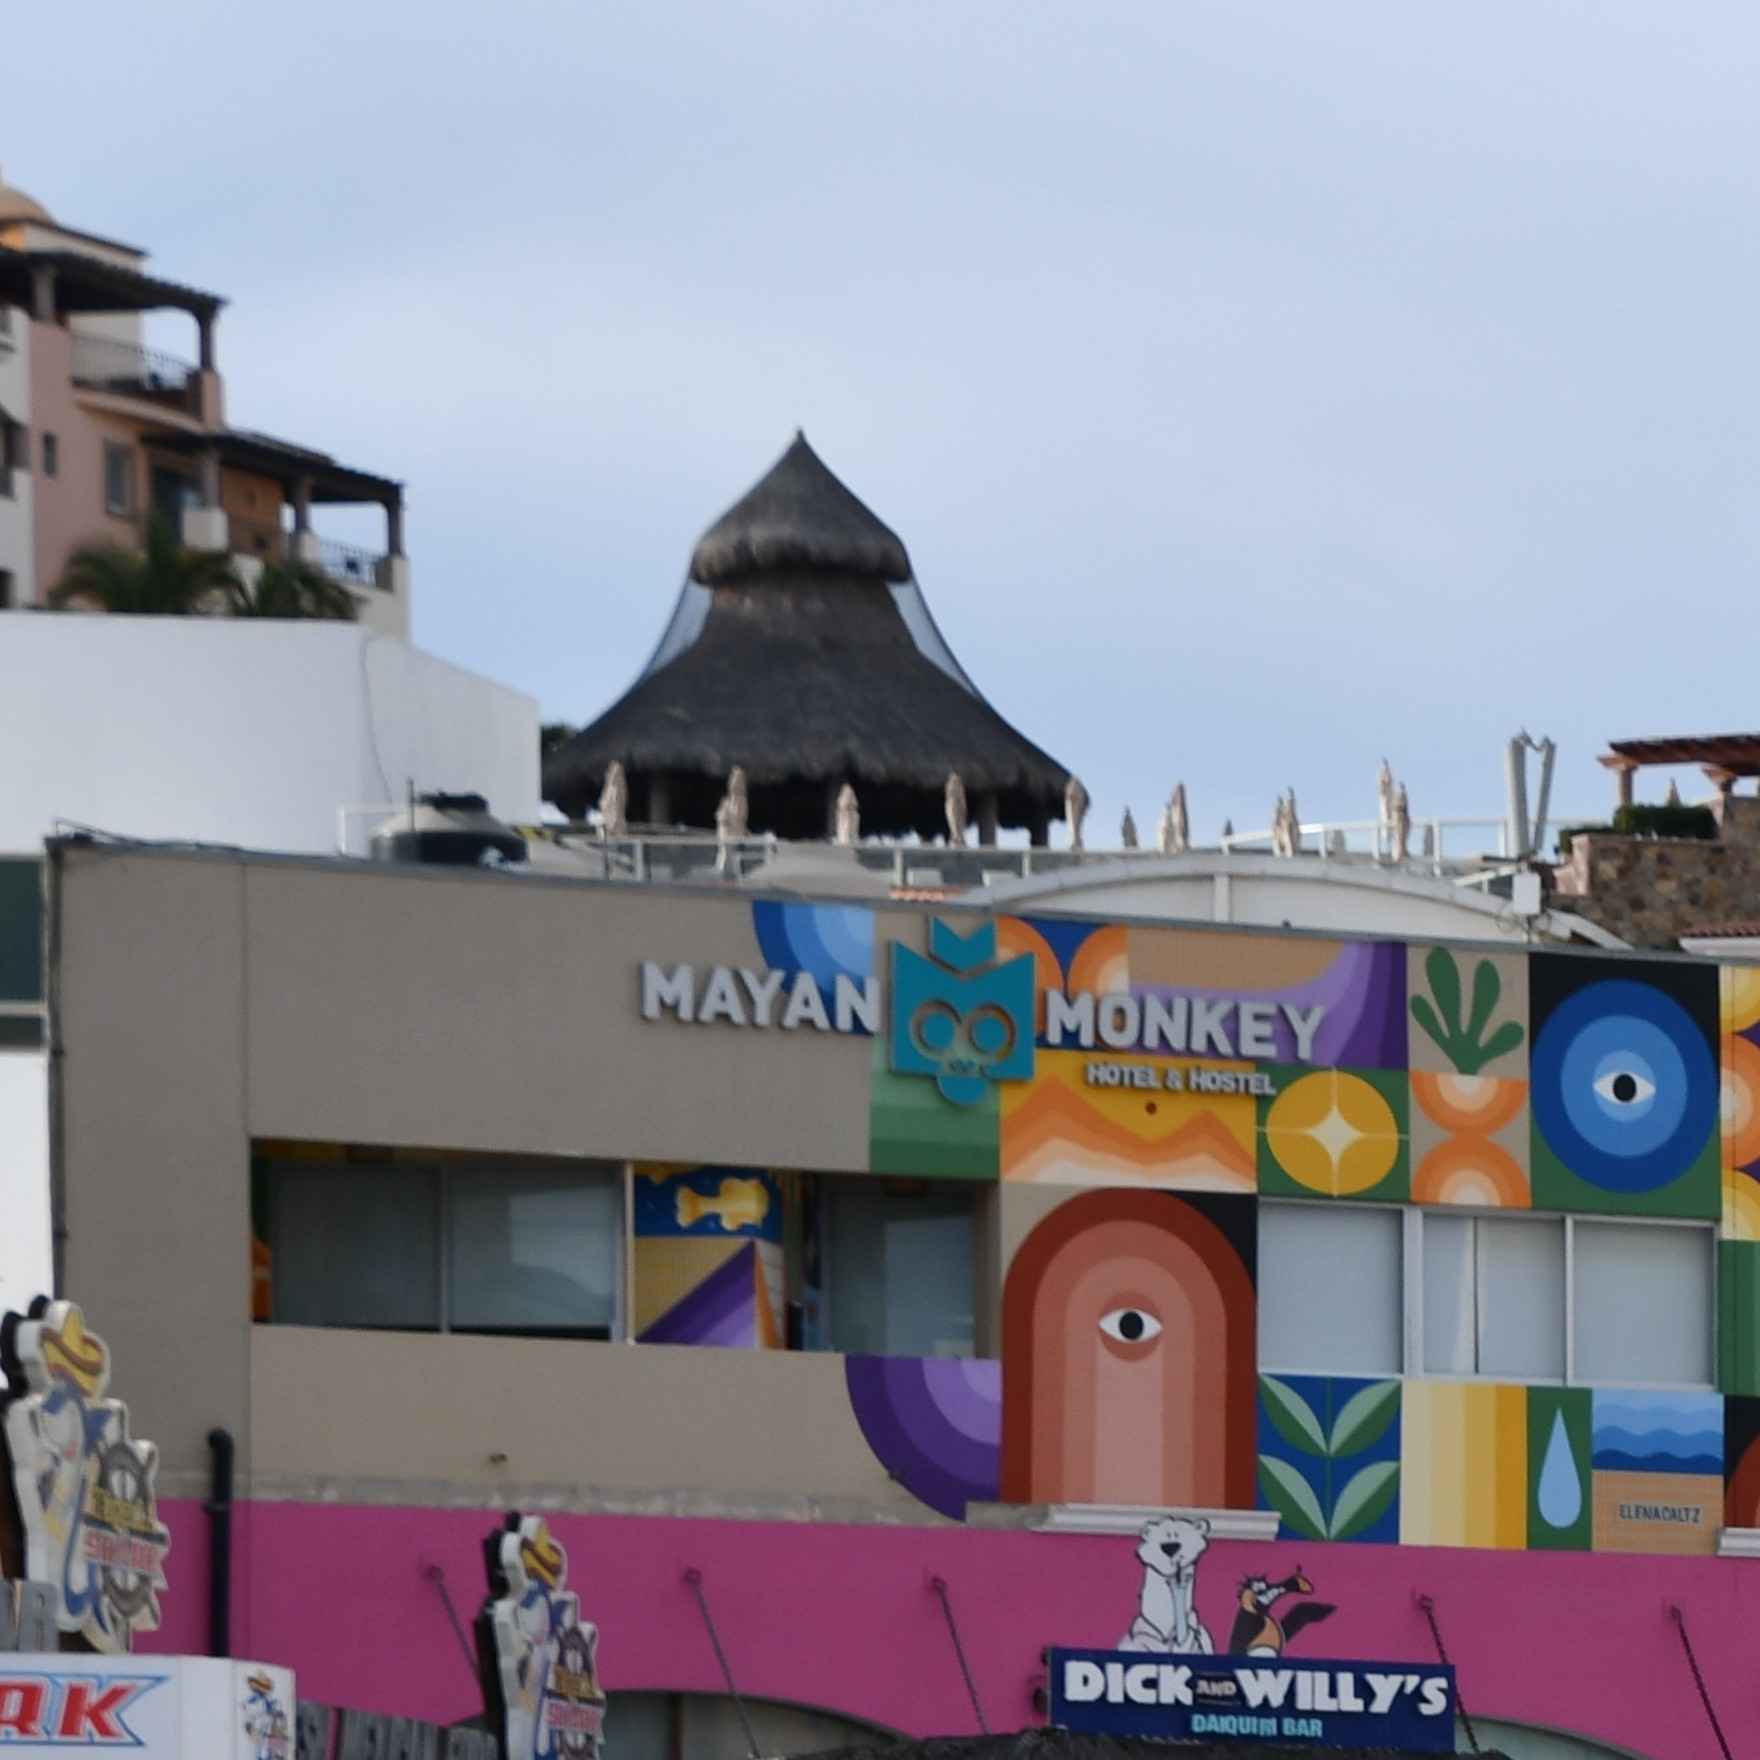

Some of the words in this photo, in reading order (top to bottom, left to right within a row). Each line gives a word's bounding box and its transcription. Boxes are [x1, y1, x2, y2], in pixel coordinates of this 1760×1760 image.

[642, 962, 880, 1035] MAYAN
[1045, 988, 1327, 1062] MONKEY
[1086, 1062, 1160, 1089] HOTEL
[1166, 1068, 1185, 1092] &
[1189, 1067, 1277, 1096] HOSTEL
[1063, 1659, 1195, 1706] DICK
[1196, 1678, 1237, 1698] AND
[1234, 1667, 1449, 1717] WILLY'S
[1191, 1713, 1278, 1737] DAIQUIRI
[1281, 1716, 1323, 1738] BAR
